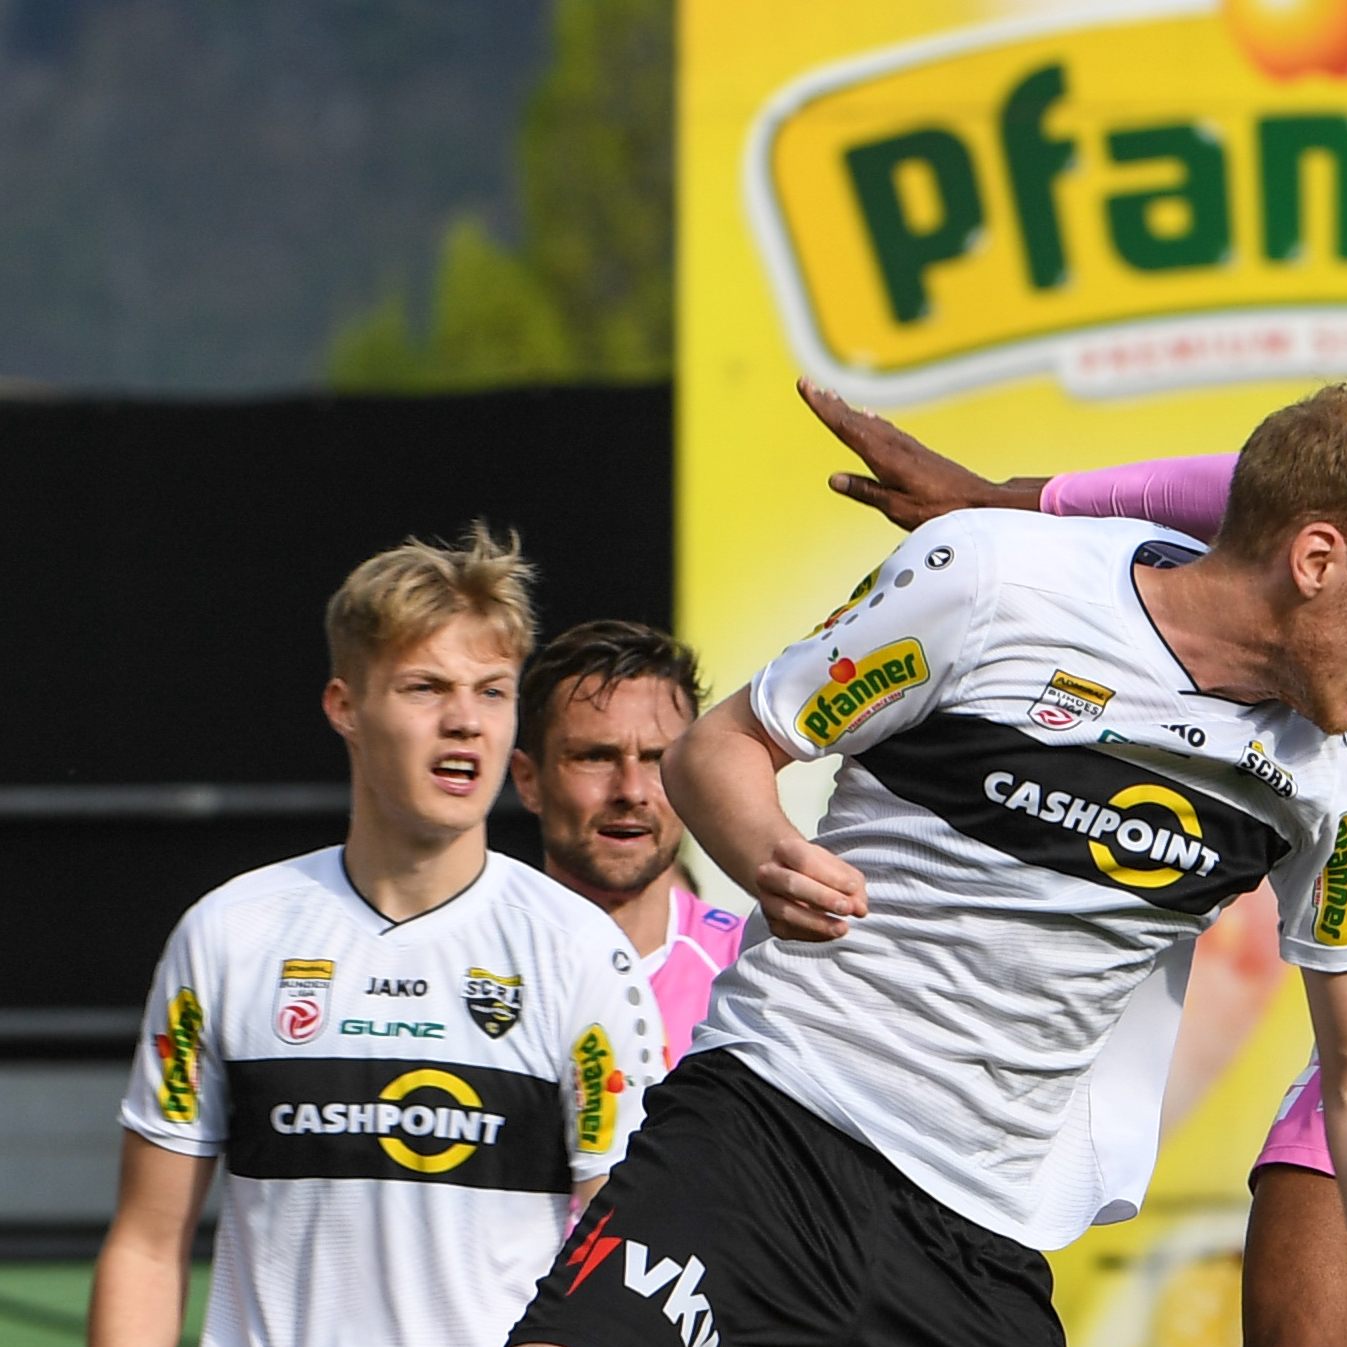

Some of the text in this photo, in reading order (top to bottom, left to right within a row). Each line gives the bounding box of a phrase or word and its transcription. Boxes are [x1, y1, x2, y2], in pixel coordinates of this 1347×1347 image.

[804, 652, 917, 741] pfanner
[983, 771, 1221, 878] CASHPOINT
[363, 977, 428, 997] JAKO
[340, 1019, 447, 1039] GUNZ
[270, 1102, 505, 1145] CASHPOINT
